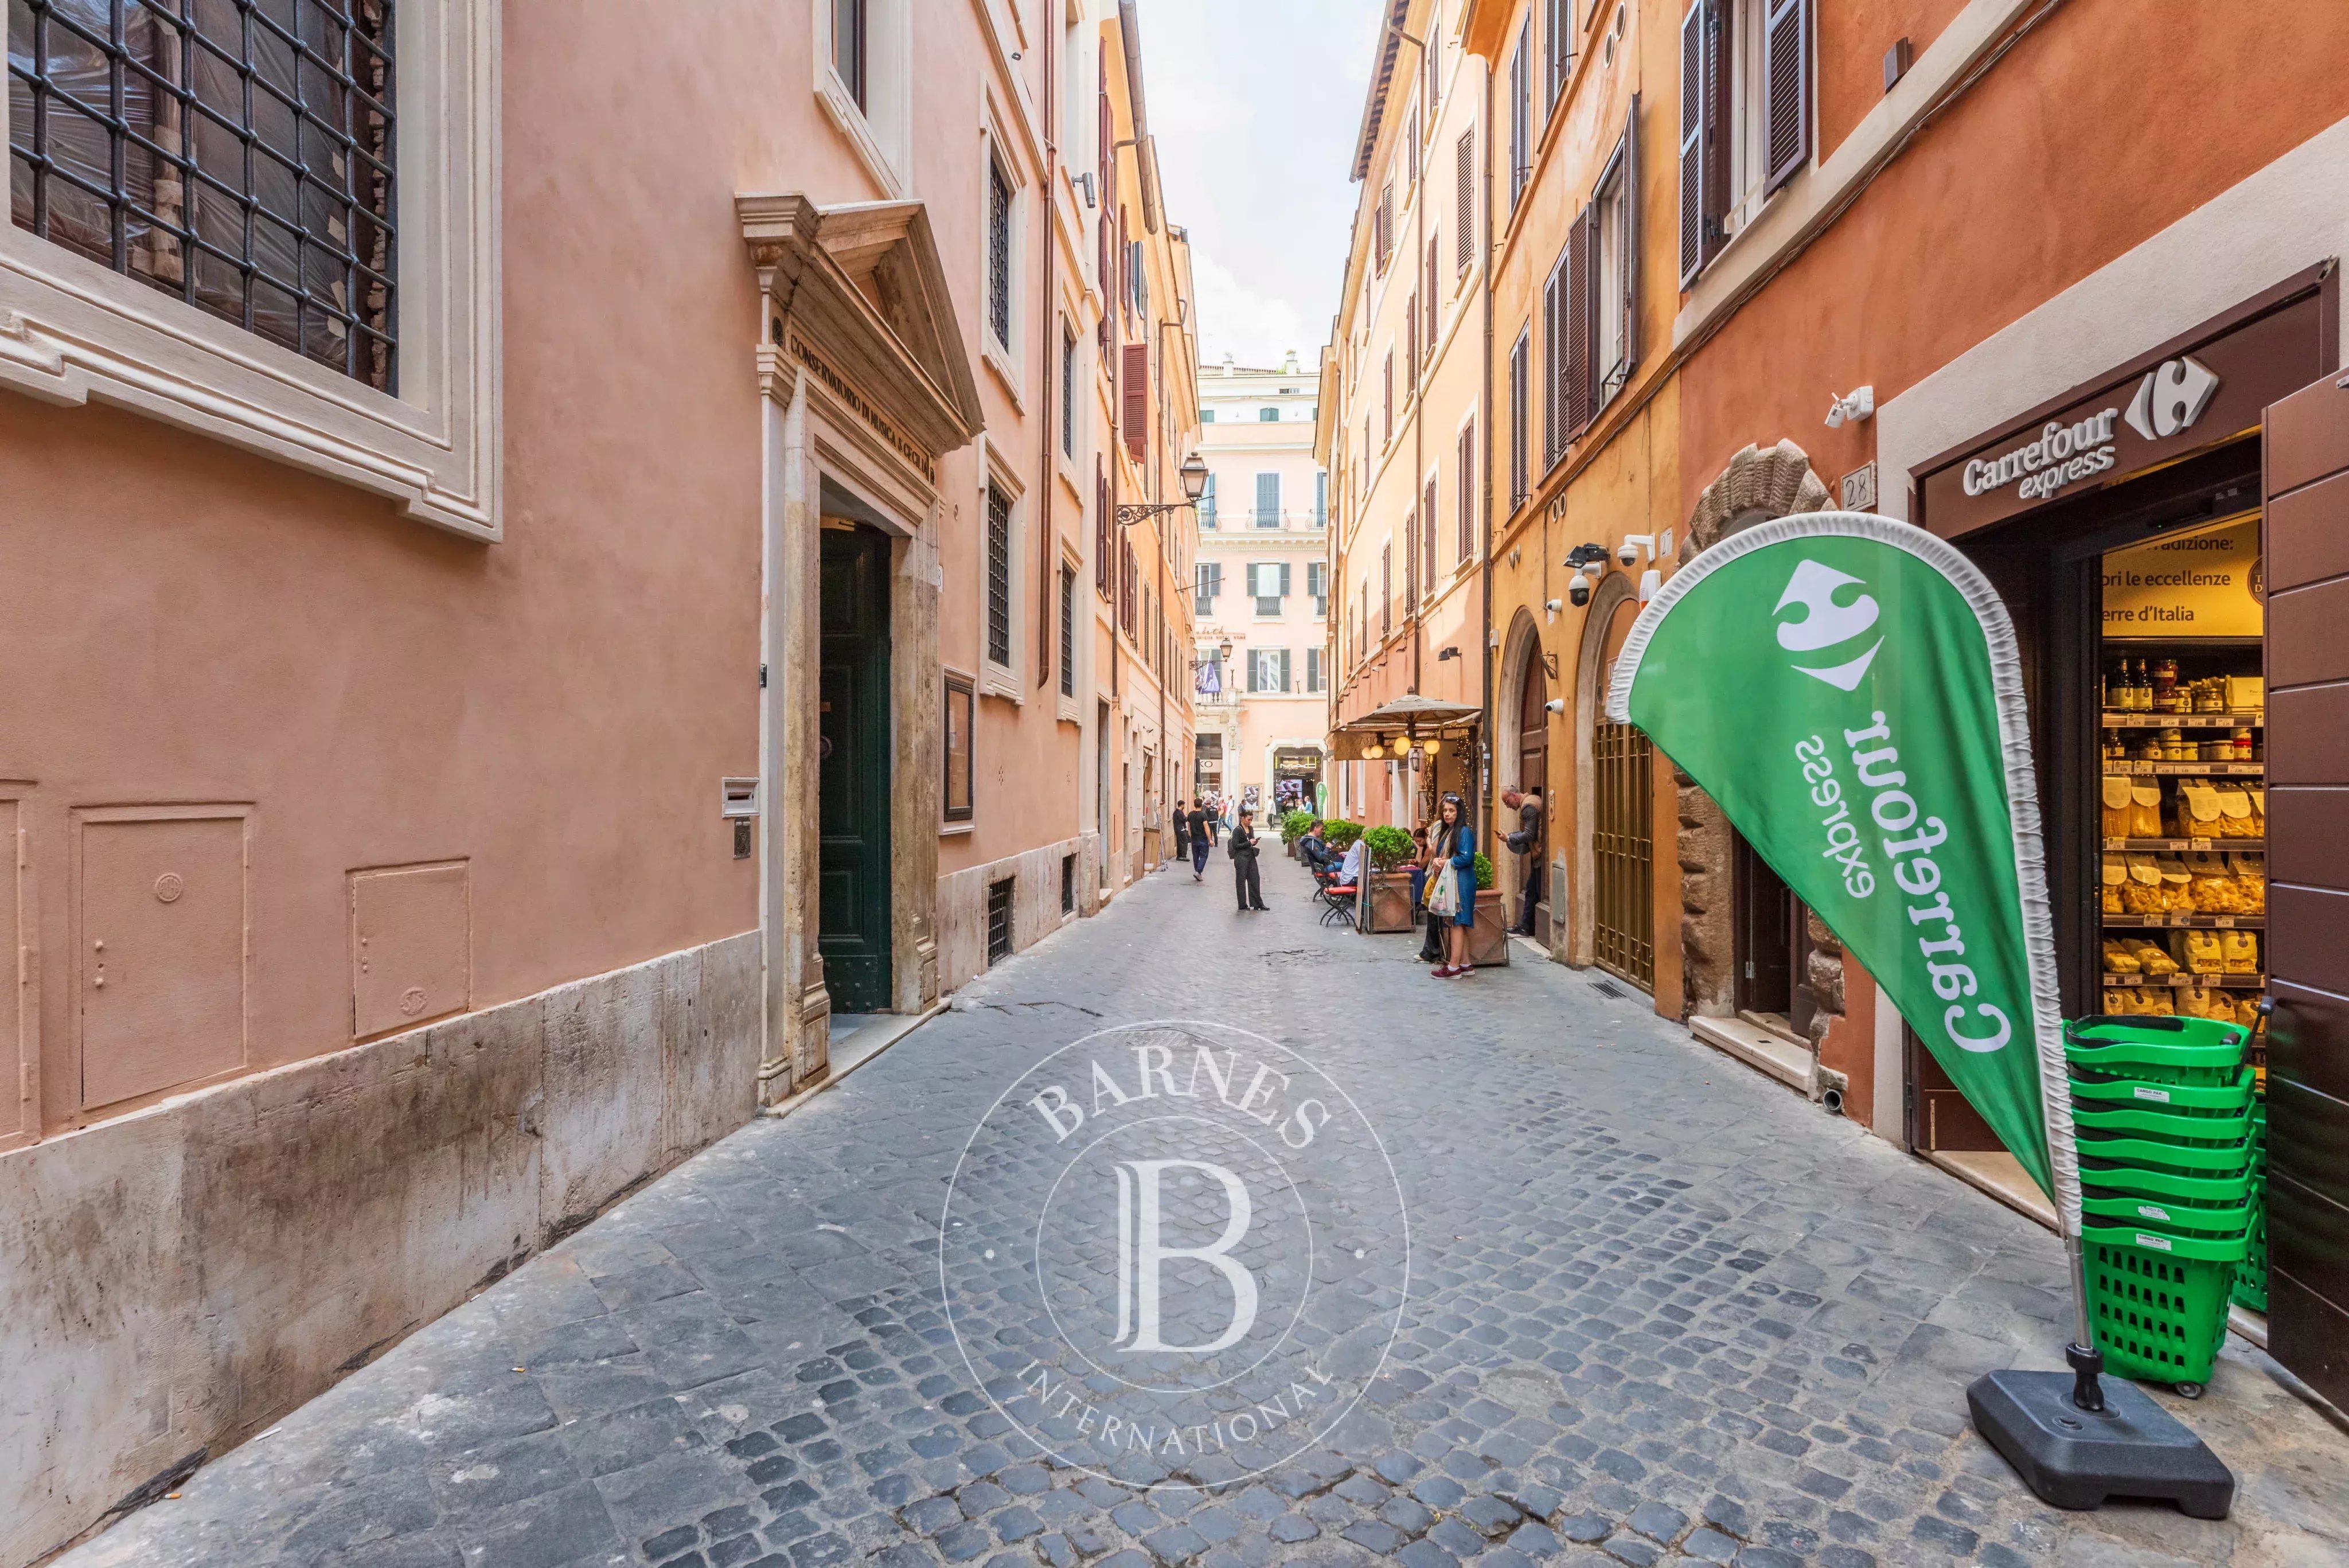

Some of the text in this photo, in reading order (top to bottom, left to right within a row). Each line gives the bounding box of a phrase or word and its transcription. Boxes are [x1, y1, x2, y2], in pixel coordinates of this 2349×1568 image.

[791, 334, 860, 411] CONSERVATORIO
[862, 401, 869, 422] DI
[871, 409, 896, 447] MUSICA
[904, 443, 928, 478] CECILIA
[1963, 408, 2118, 496] Carrefour
[2019, 446, 2116, 499] express
[1846, 474, 1867, 508] 28
[2147, 536, 2233, 551] adizione:
[2126, 570, 2141, 586] le
[2145, 570, 2231, 586] eccellenze
